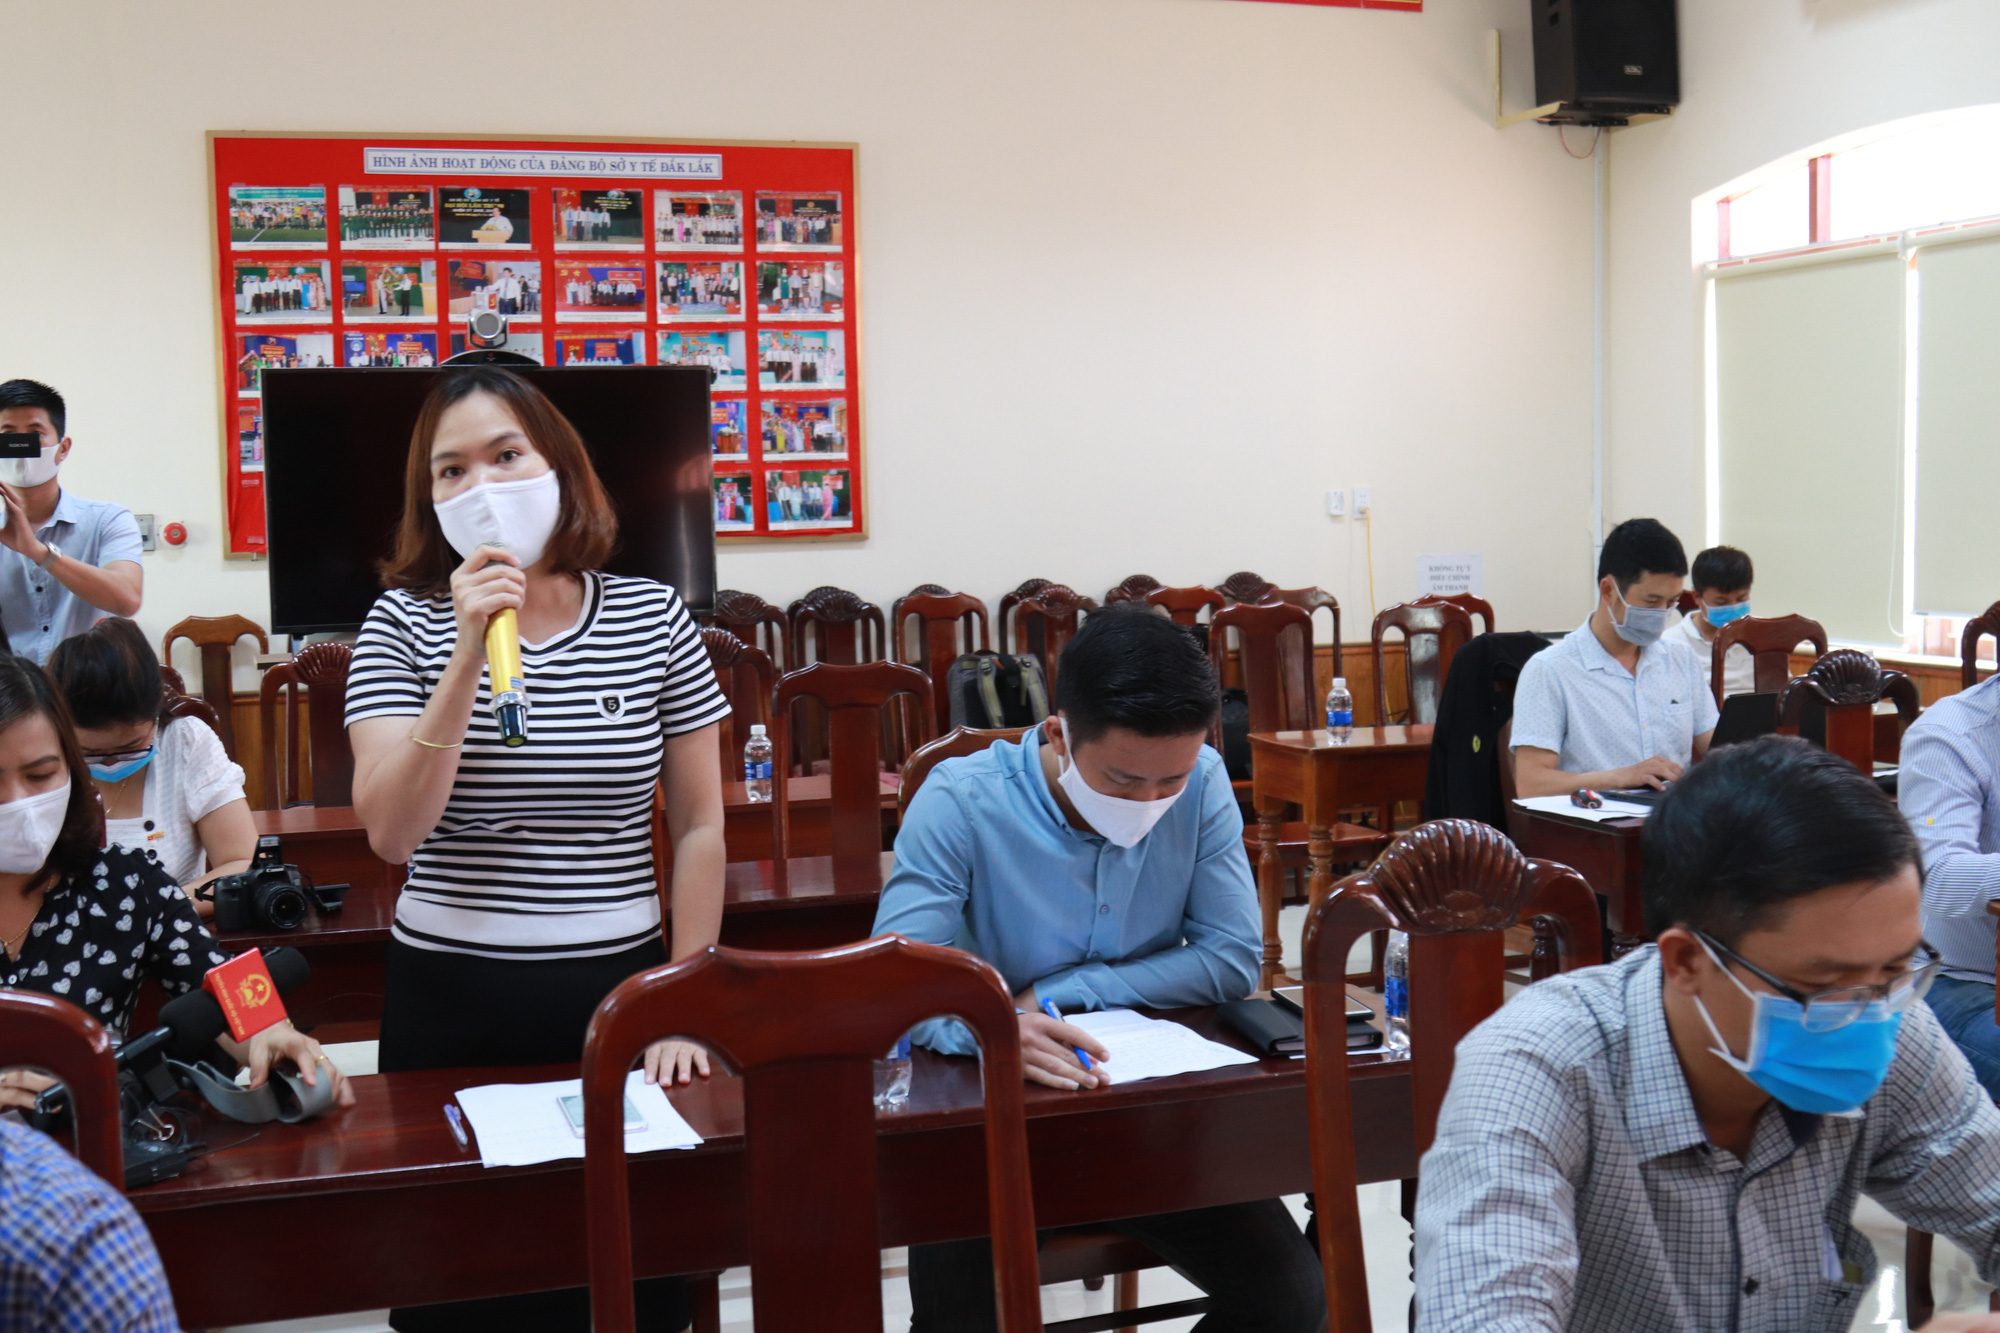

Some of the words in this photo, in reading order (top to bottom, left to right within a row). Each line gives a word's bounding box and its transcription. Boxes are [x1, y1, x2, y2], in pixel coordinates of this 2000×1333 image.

[373, 153, 406, 168] HÌNH
[410, 153, 438, 168] ẢNH
[442, 156, 476, 171] HOẠT
[480, 155, 517, 171] ĐỘNG
[520, 155, 546, 170] CỦA
[550, 156, 586, 171] ĐẢNG
[589, 158, 606, 173] BỘ
[609, 157, 626, 172] SỞ
[629, 161, 638, 172] Y
[641, 158, 657, 172] TẾ
